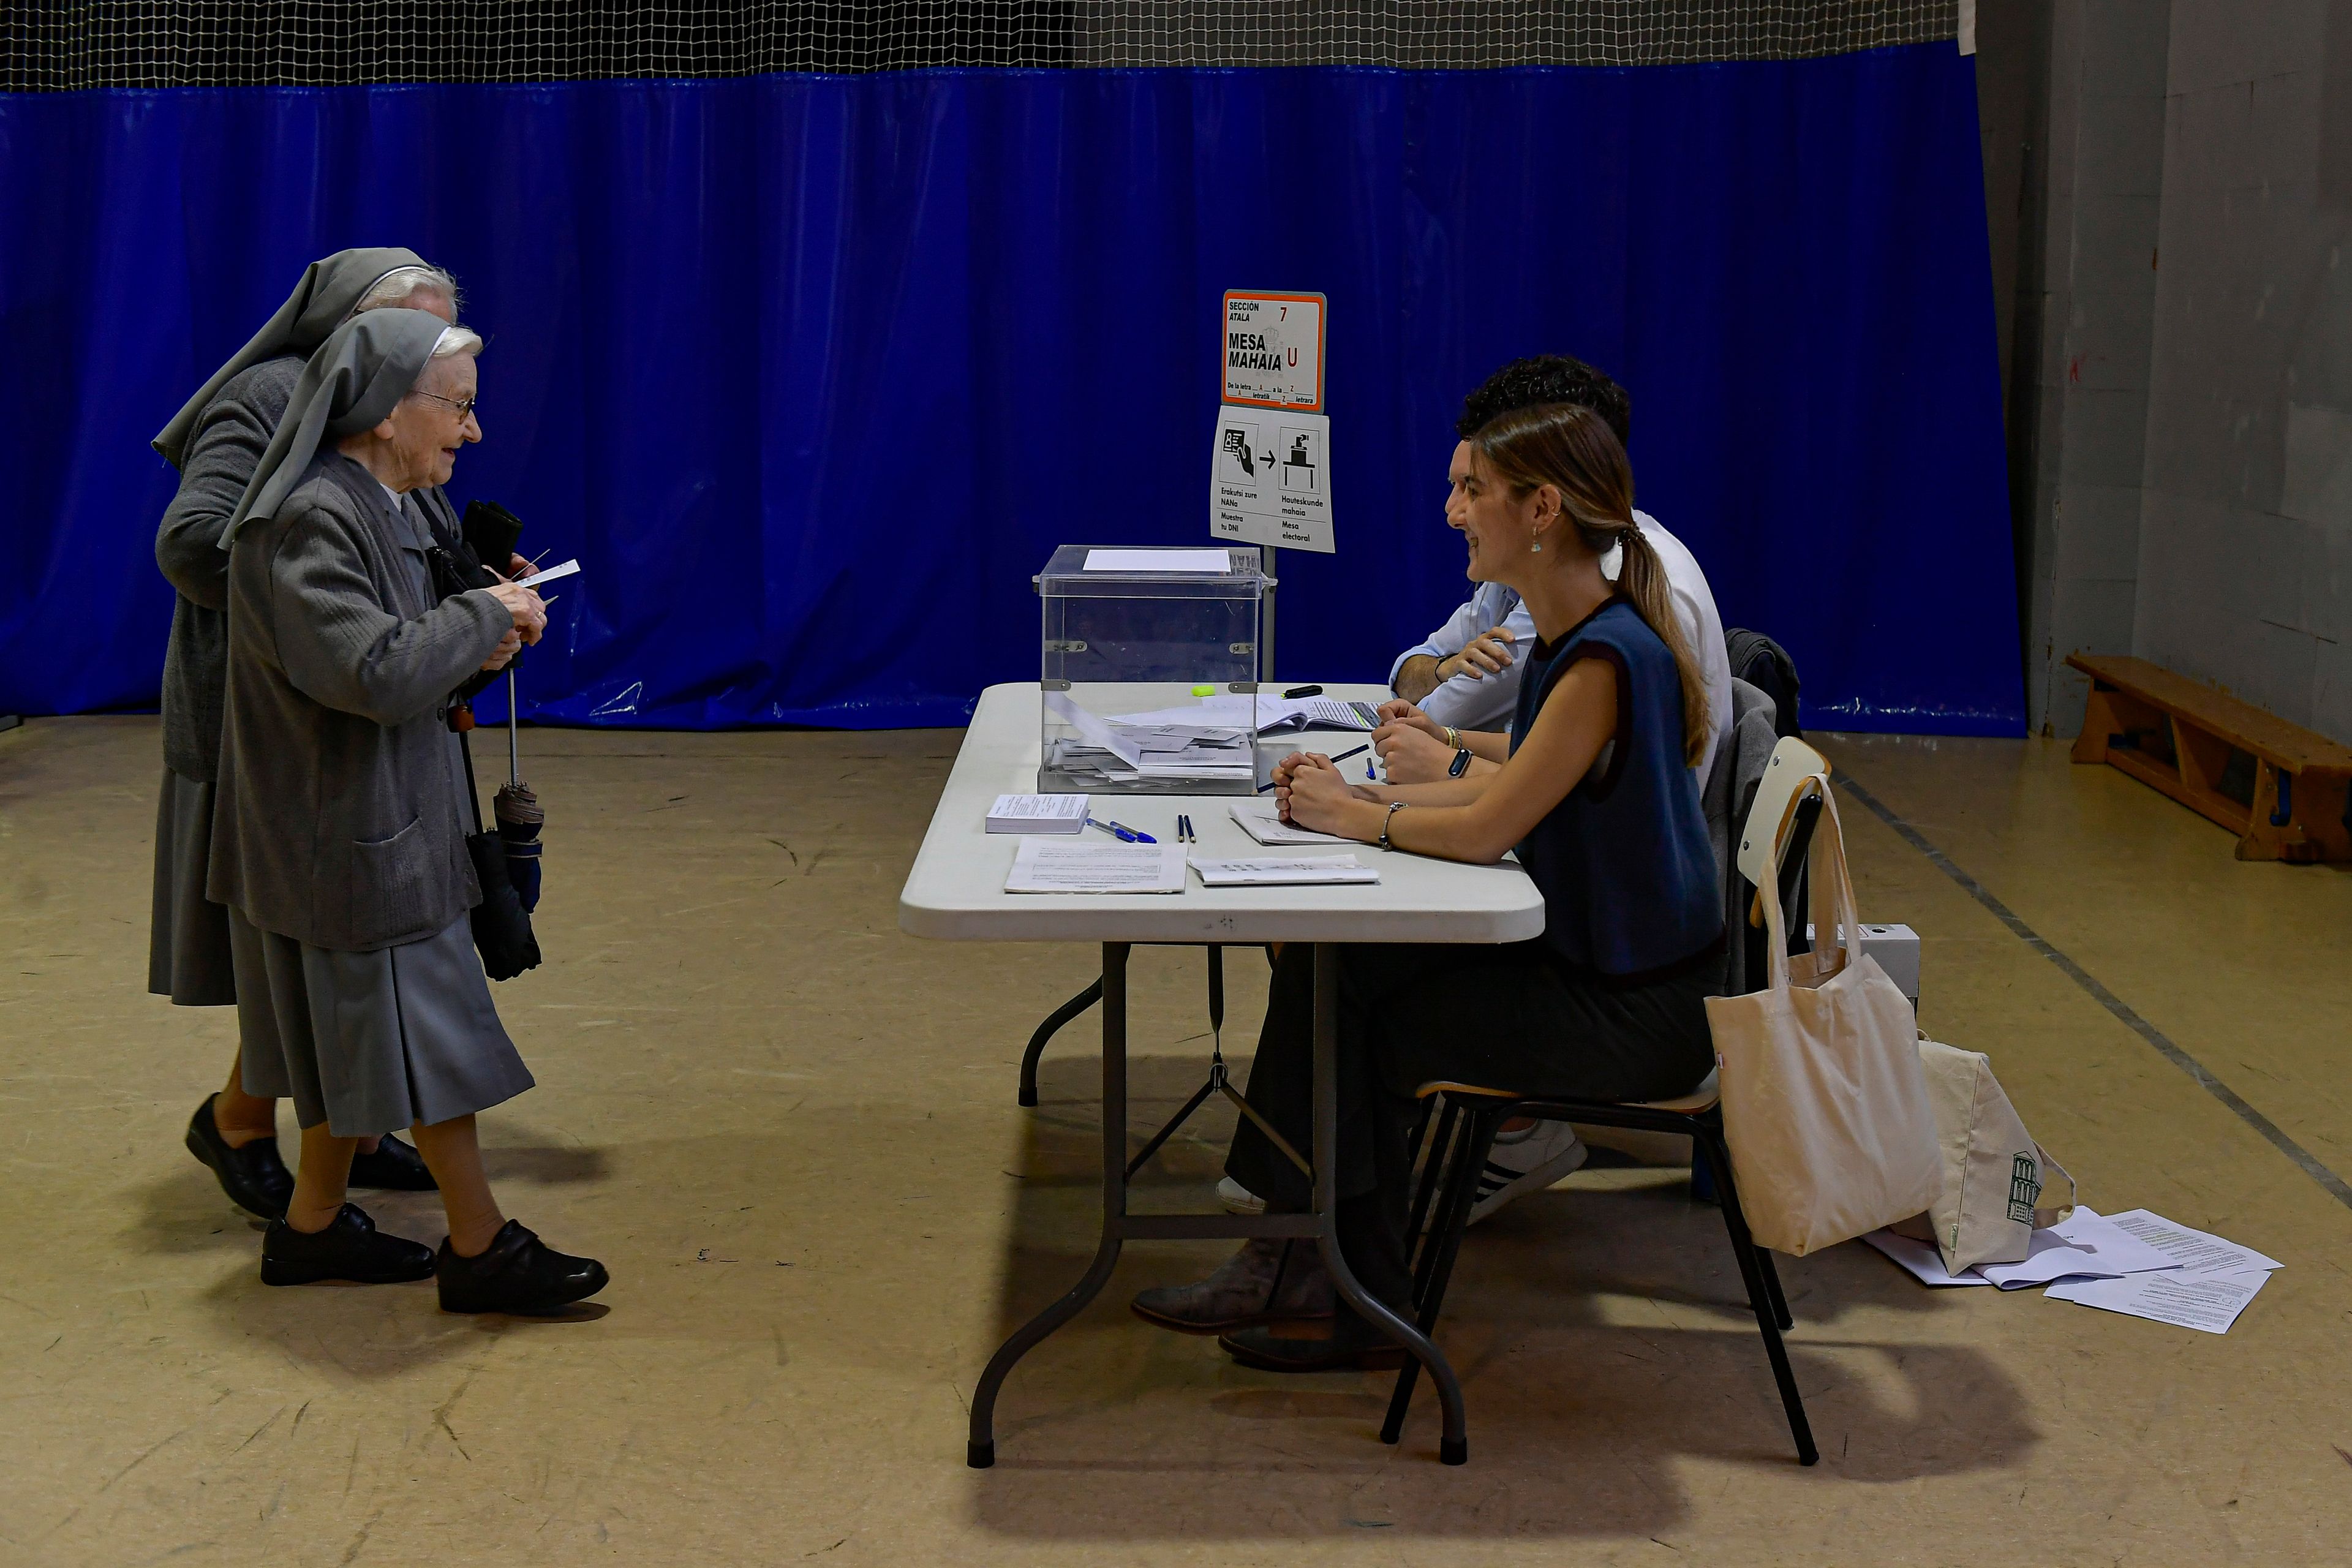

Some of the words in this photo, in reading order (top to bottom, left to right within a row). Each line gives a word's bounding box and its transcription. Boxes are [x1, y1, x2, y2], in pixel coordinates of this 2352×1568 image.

[1229, 301, 1259, 311] SECCIÓN
[1229, 313, 1250, 322] ATALA
[1280, 307, 1287, 322] 7
[1229, 333, 1265, 351] MESA
[1229, 352, 1281, 371] MAHAIA
[1287, 347, 1297, 367] U
[1221, 488, 1243, 497] Erakutsi
[1221, 498, 1238, 507] NANa
[1281, 496, 1323, 507] Hauteskunde
[1281, 507, 1305, 516] mahaia
[1221, 512, 1243, 522] Muestra
[1228, 524, 1238, 532] DNI
[1282, 521, 1299, 530] Mesa
[1283, 533, 1310, 542] electoral
